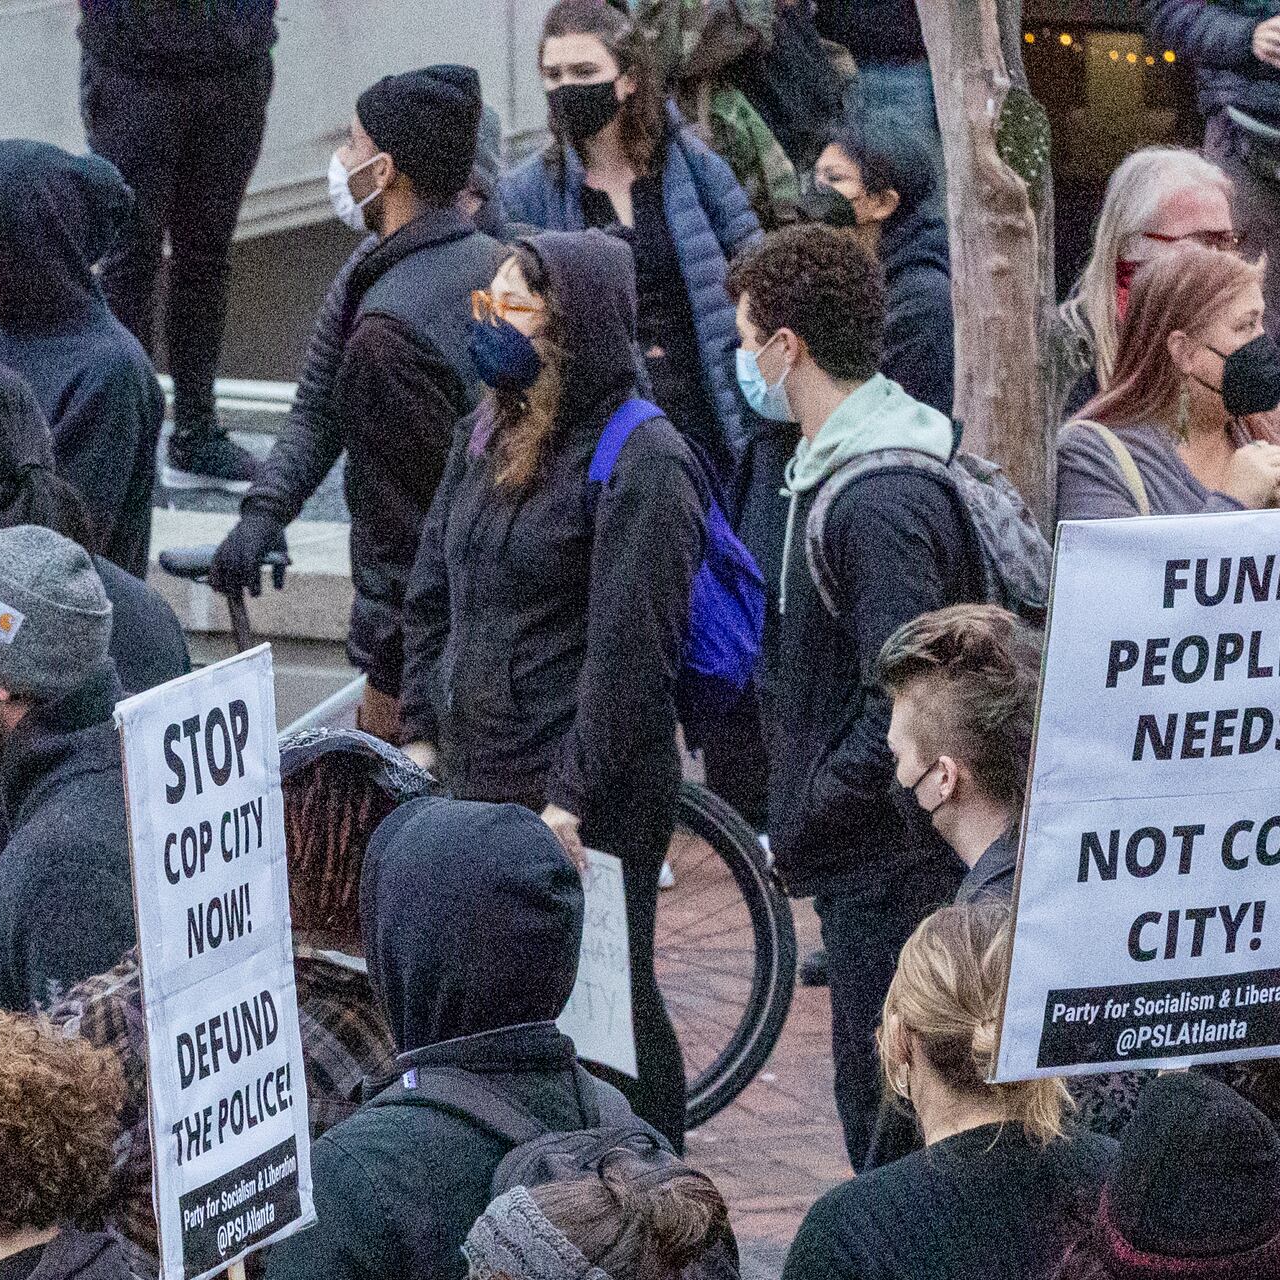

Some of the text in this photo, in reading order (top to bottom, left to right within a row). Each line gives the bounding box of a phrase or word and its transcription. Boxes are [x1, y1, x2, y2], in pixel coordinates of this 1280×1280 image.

[163, 699, 249, 805] STOP
[164, 796, 263, 885] COP CITY
[1077, 823, 1205, 883] NOT
[187, 882, 253, 958] NOW!
[1127, 900, 1267, 962] CITY!
[176, 989, 279, 1090] DEFUND
[1052, 1001, 1100, 1026] Party
[1103, 998, 1130, 1020] for
[1134, 991, 1214, 1018] Socialism
[1218, 990, 1230, 1009] &
[1116, 1018, 1248, 1057] @PSLAtlanta
[172, 1062, 293, 1167] THE POLICE!
[184, 1154, 297, 1232] Party for Socialism & Liberation
[216, 1203, 275, 1256] @PSLAtlanta
